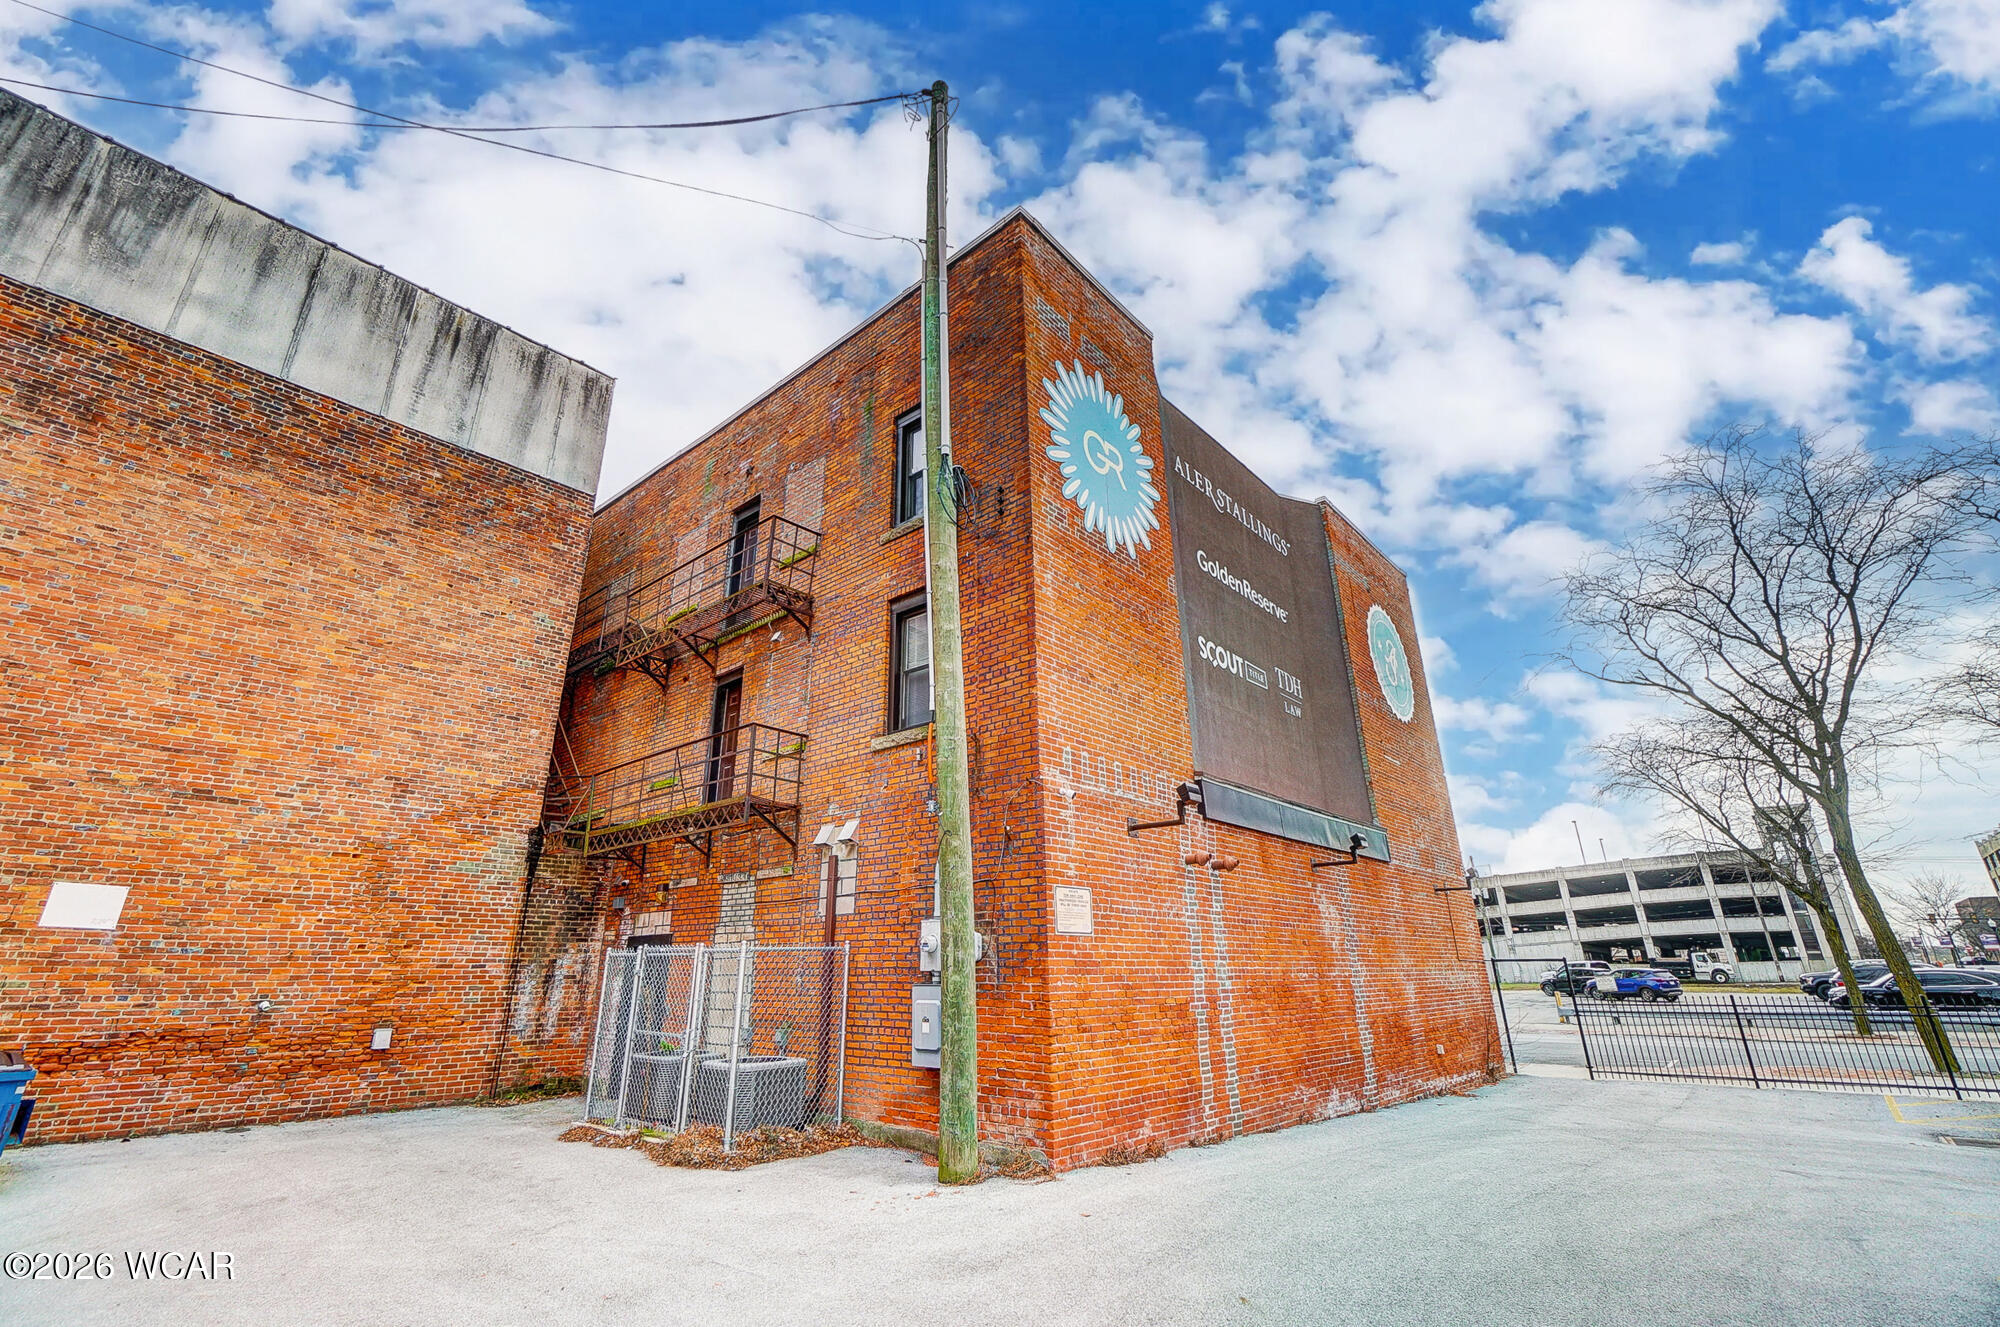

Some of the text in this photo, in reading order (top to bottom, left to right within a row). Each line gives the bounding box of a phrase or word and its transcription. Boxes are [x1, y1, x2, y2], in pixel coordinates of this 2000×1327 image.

[1196, 549, 1286, 623] GoldenReserve
[1197, 635, 1243, 678] SCOUT
[1273, 666, 1303, 699] TDH
[1284, 701, 1302, 718] LAW
